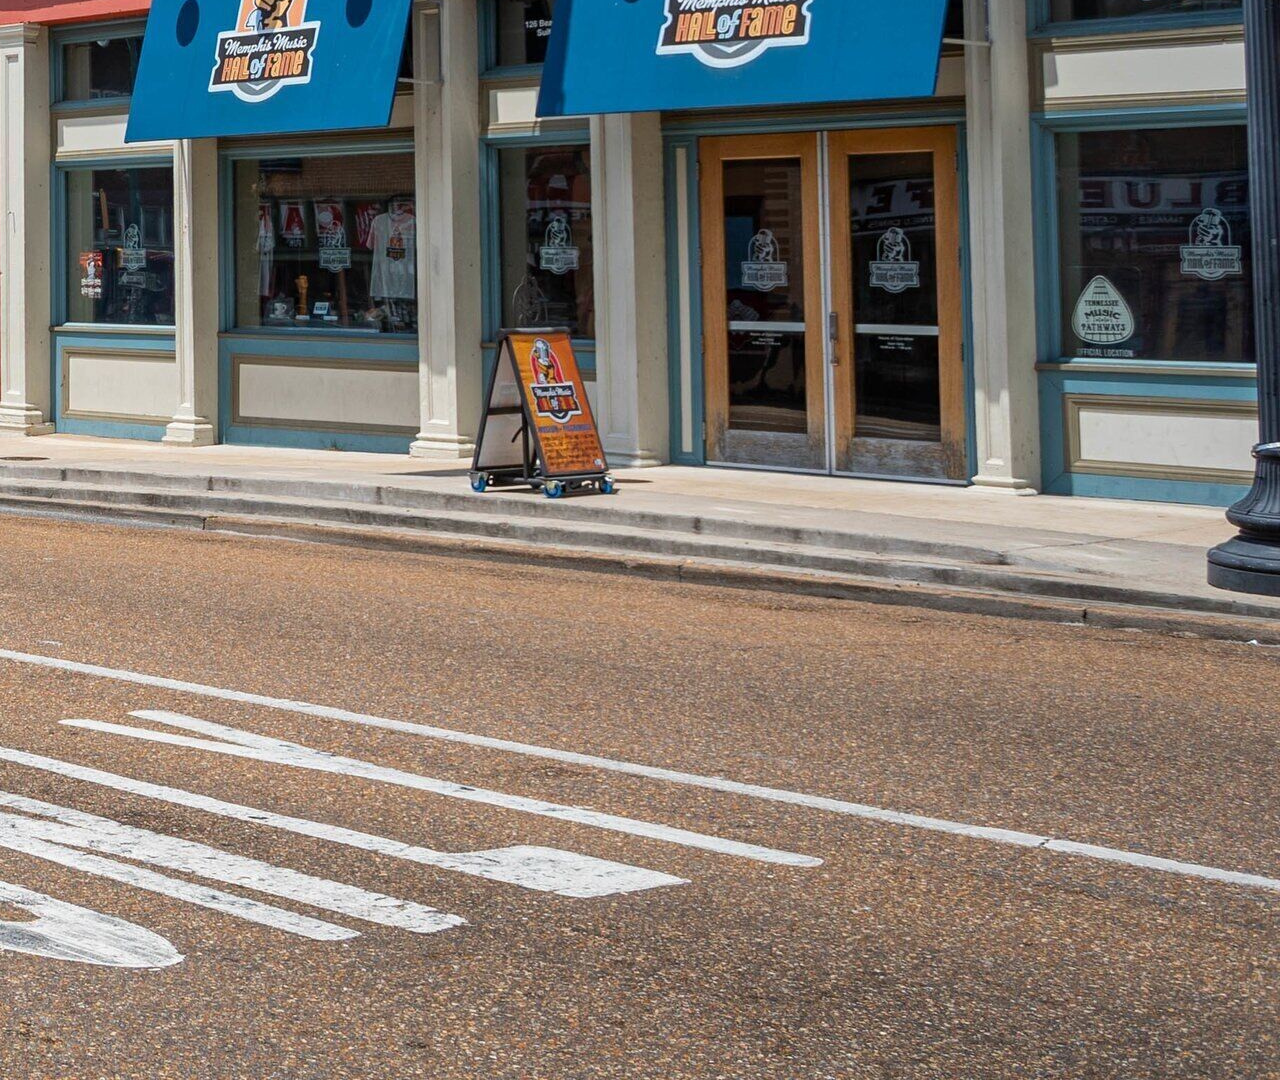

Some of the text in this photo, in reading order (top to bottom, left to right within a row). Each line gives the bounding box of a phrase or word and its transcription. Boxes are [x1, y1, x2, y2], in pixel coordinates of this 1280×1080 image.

[674, 11, 717, 43] HALL
[716, 8, 742, 39] of
[224, 33, 308, 60] Memphis Music
[221, 56, 250, 81] HALL
[249, 53, 268, 78] of
[1081, 323, 1126, 332] PATHWAYS
[1084, 309, 1121, 320] MUSIC
